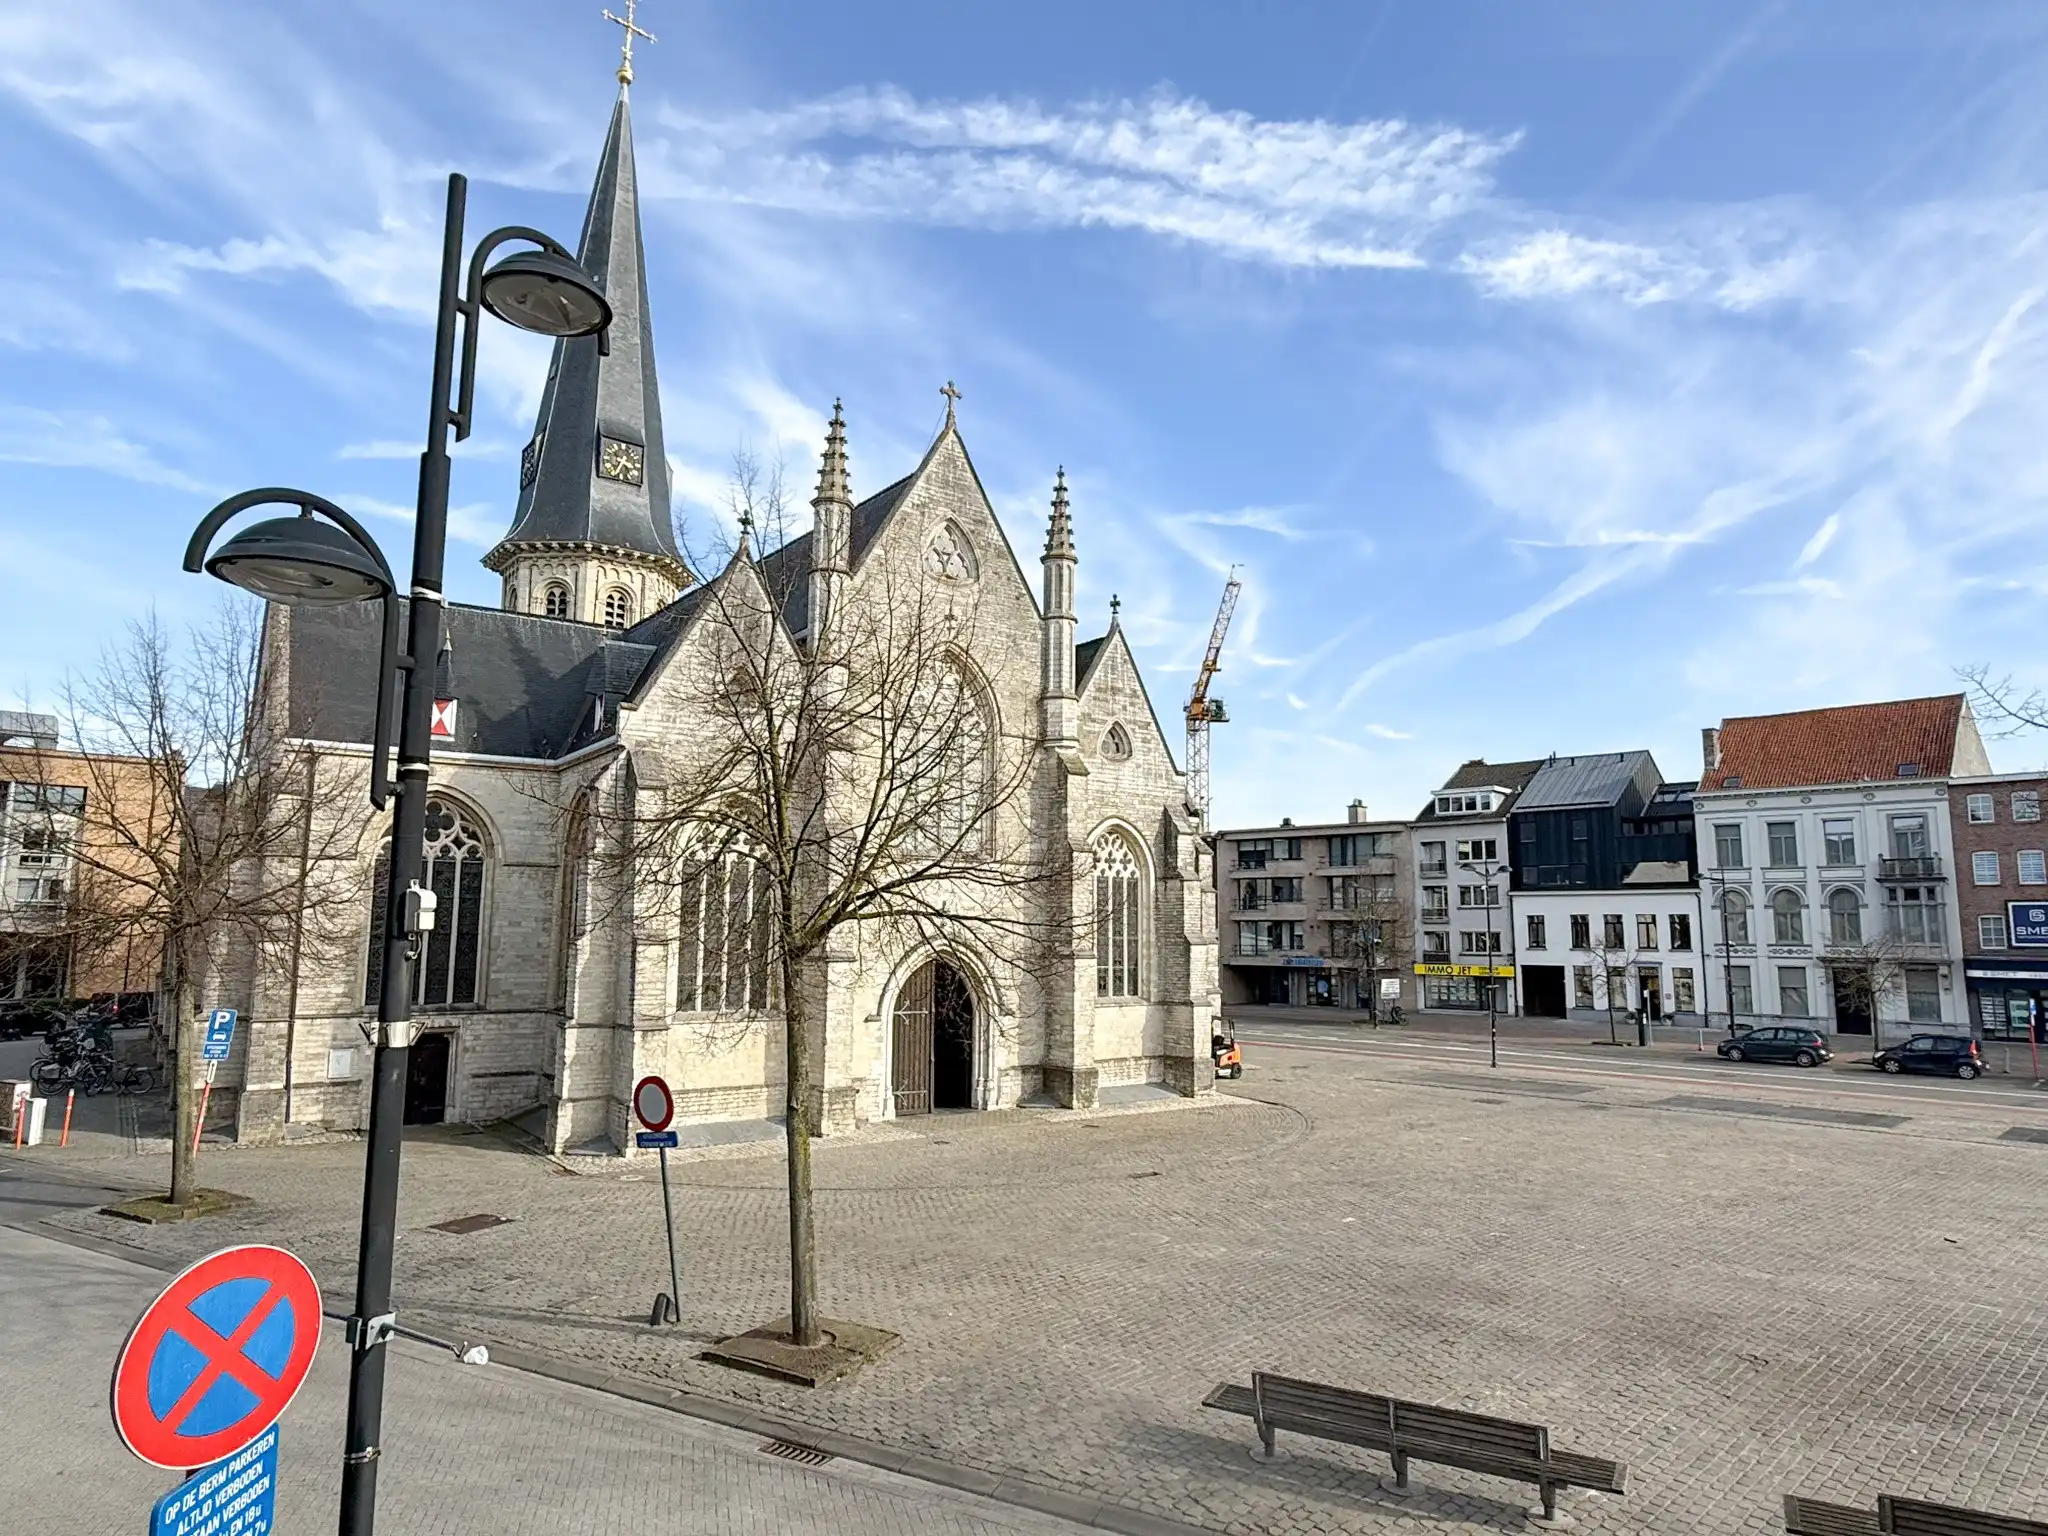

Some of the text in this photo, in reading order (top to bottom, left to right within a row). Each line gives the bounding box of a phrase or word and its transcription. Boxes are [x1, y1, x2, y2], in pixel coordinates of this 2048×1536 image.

[1424, 966, 1453, 975] IMMO
[1456, 967, 1472, 975] JET
[214, 1011, 231, 1029] P
[165, 1431, 275, 1525] OP DE BERM PARKEREN
[176, 1460, 264, 1536] ALTIJD VERBODEN
[222, 1474, 271, 1523] VERBODEN
[230, 1515, 243, 1536] EN
